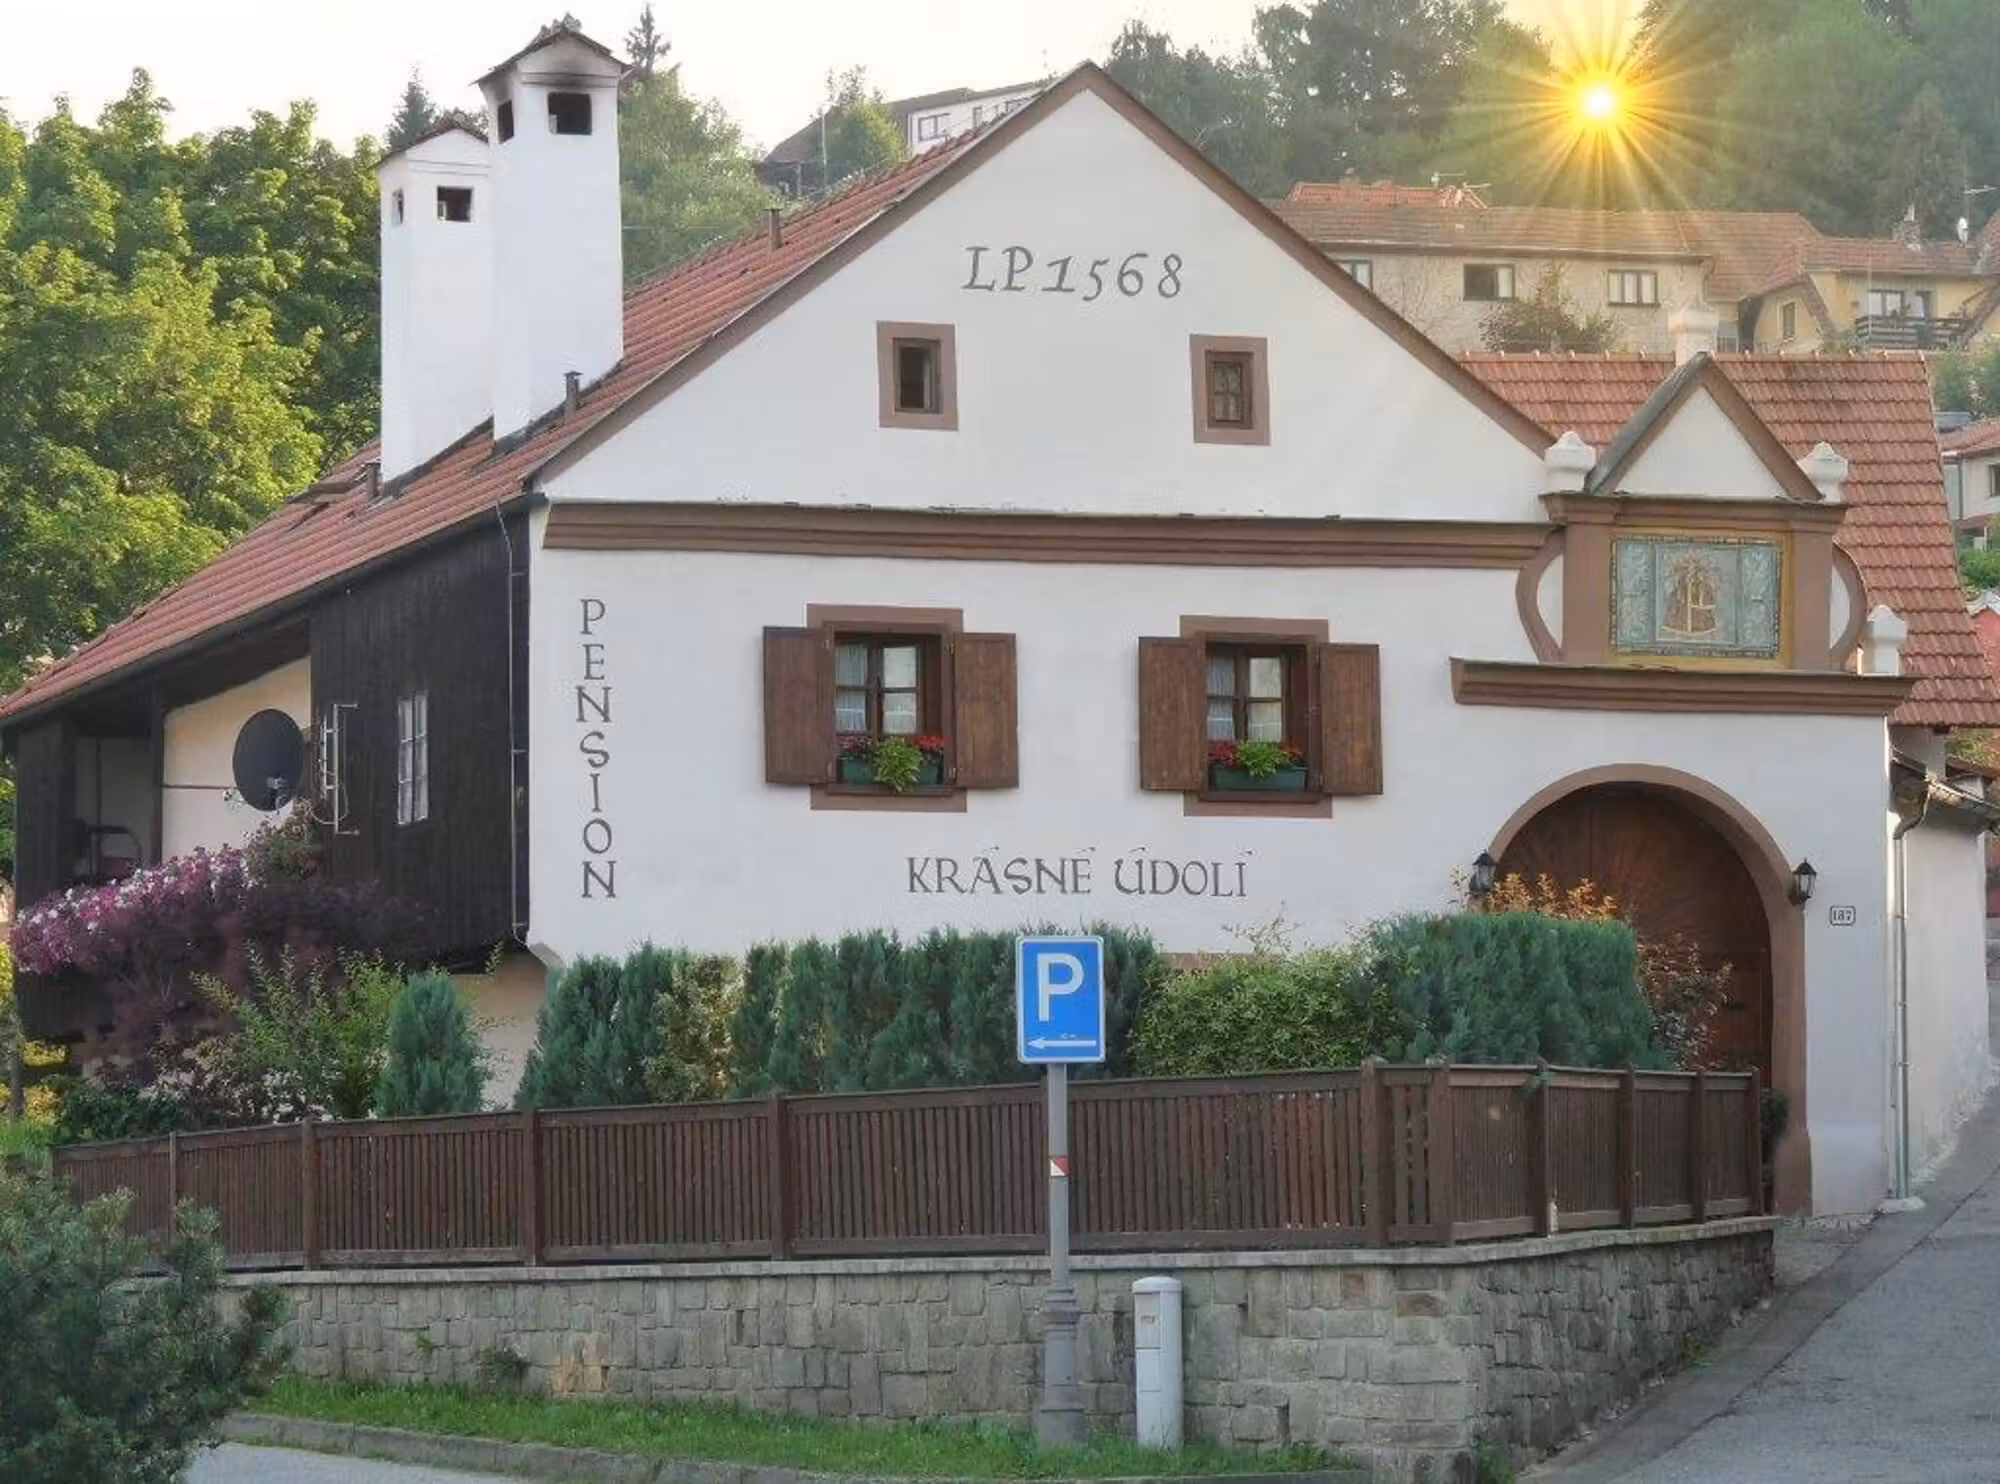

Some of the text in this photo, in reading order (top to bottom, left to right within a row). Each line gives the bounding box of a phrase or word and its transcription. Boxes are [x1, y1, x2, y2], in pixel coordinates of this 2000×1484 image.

[575, 598, 616, 898] PENSION
[907, 846, 1252, 897] KRÁSNÉ ÚDOLÍ
[1037, 952, 1084, 1021] P
